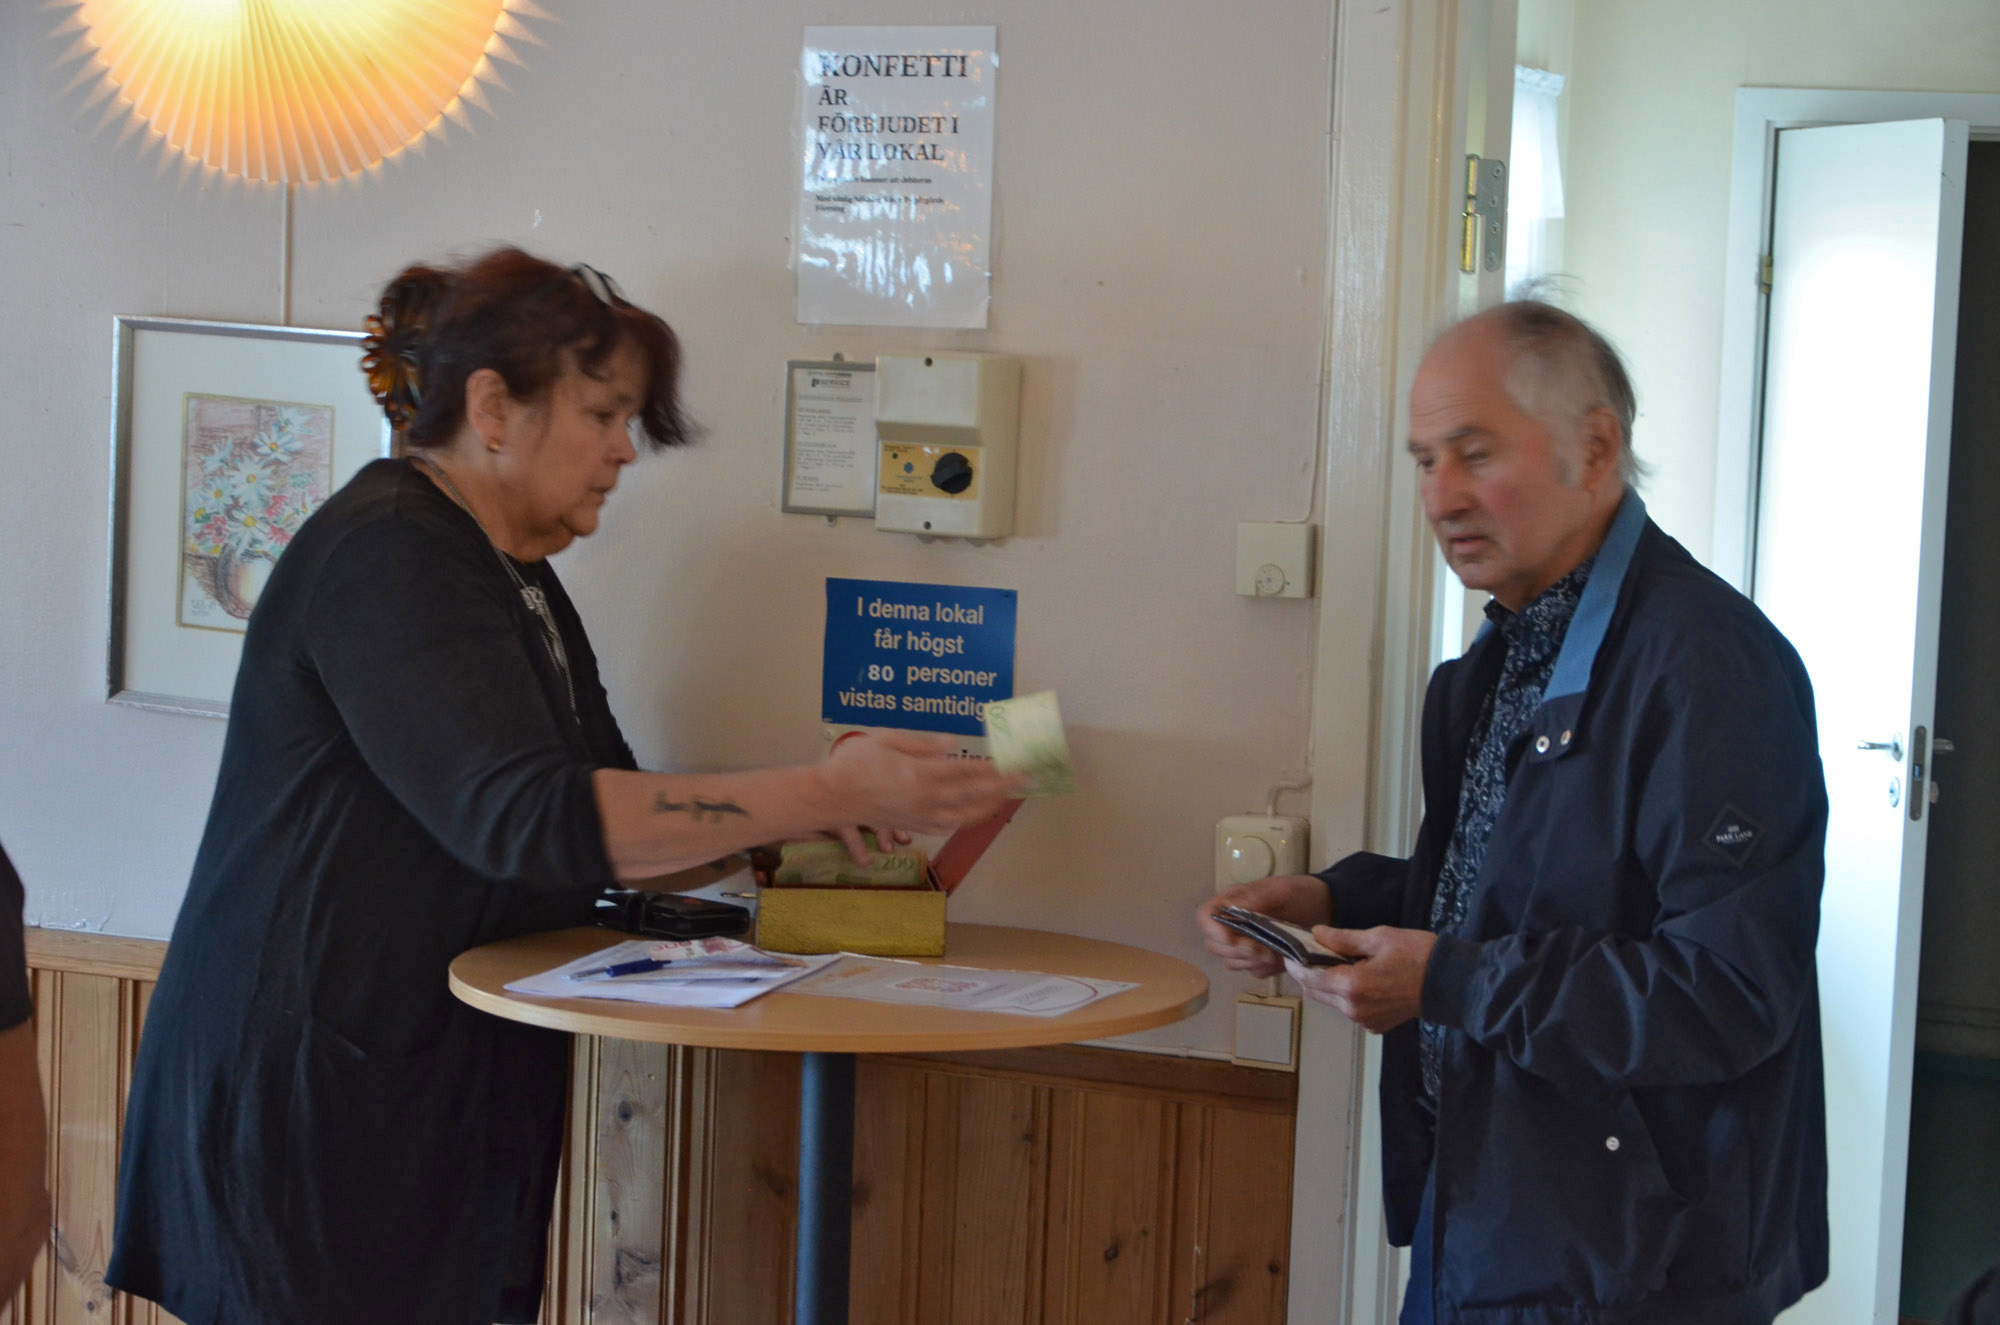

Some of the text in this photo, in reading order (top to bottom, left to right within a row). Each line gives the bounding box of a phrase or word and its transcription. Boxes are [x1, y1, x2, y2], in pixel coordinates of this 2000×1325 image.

[818, 54, 969, 78] KONFETTI
[819, 85, 848, 106] ÄR
[818, 112, 960, 134] FÖRBJUDET I
[816, 140, 945, 162] VÅR LOKAL
[857, 596, 984, 625] I denna lokal
[874, 628, 965, 657] får högst
[867, 664, 998, 687] 80 personer
[839, 687, 995, 722] vistas samtidig
